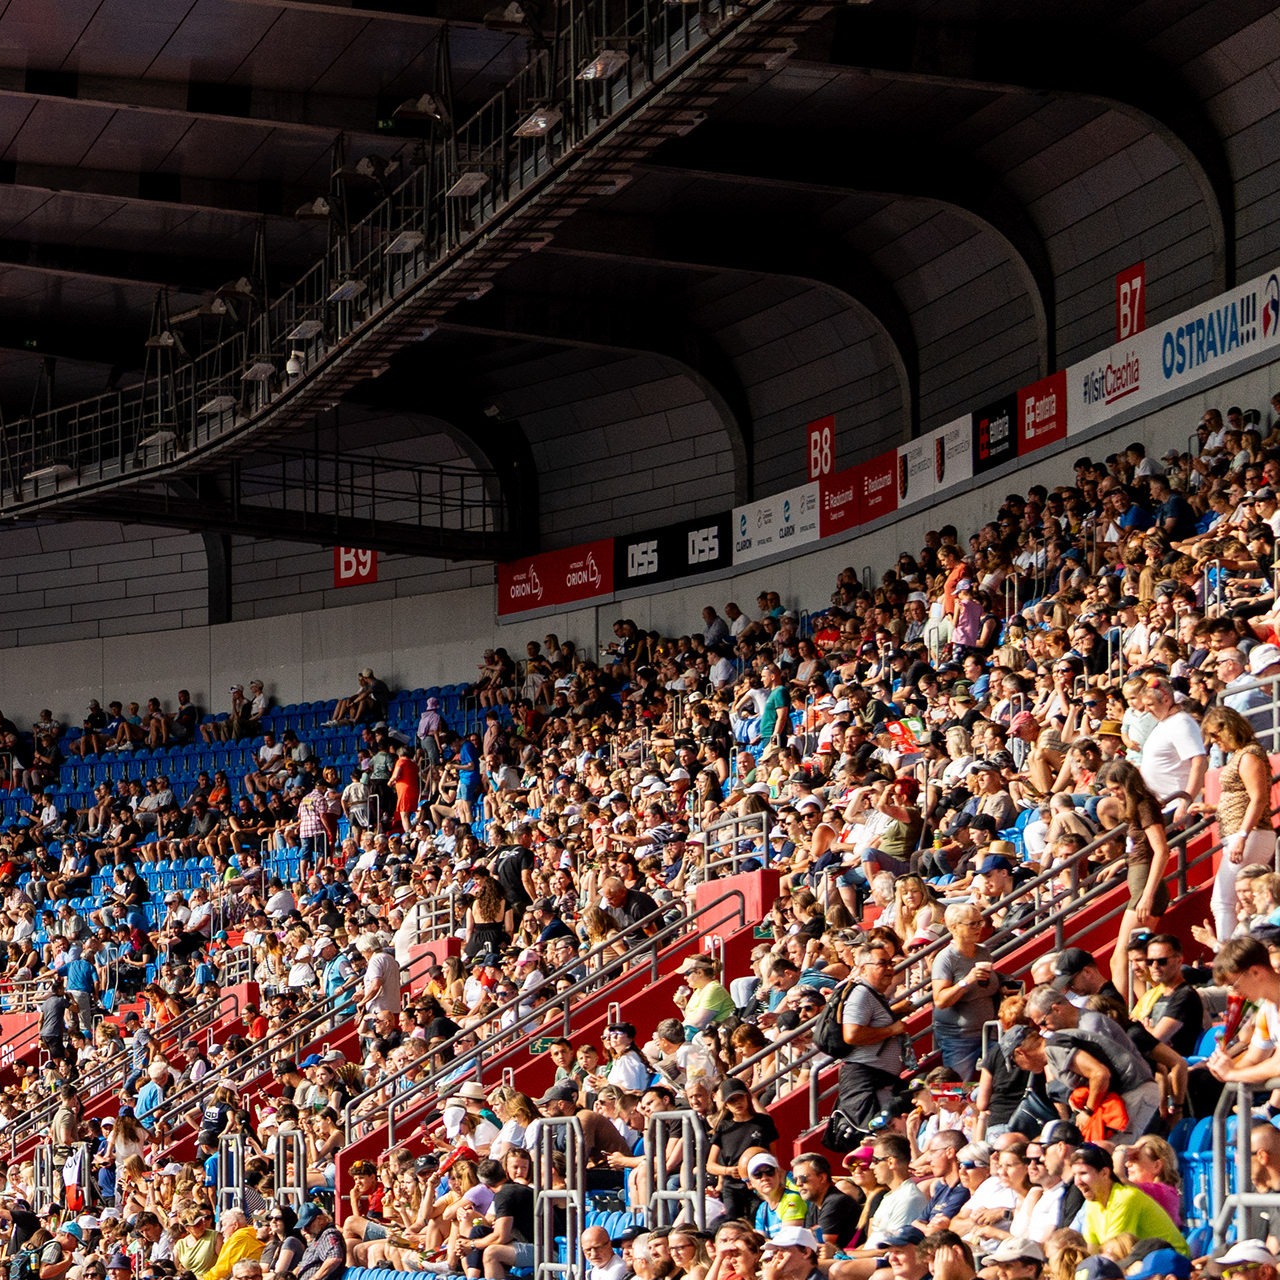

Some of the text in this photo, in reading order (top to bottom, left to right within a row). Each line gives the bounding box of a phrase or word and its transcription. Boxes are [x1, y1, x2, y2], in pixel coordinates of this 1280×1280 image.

[1120, 276, 1142, 340] B7
[1162, 292, 1257, 380] OSTRAVA!!!
[810, 427, 832, 479] B8
[340, 547, 372, 580] B9
[627, 540, 658, 578] DSS
[688, 526, 719, 565] DSS
[510, 582, 531, 599] ORION
[566, 571, 588, 587] ORION
